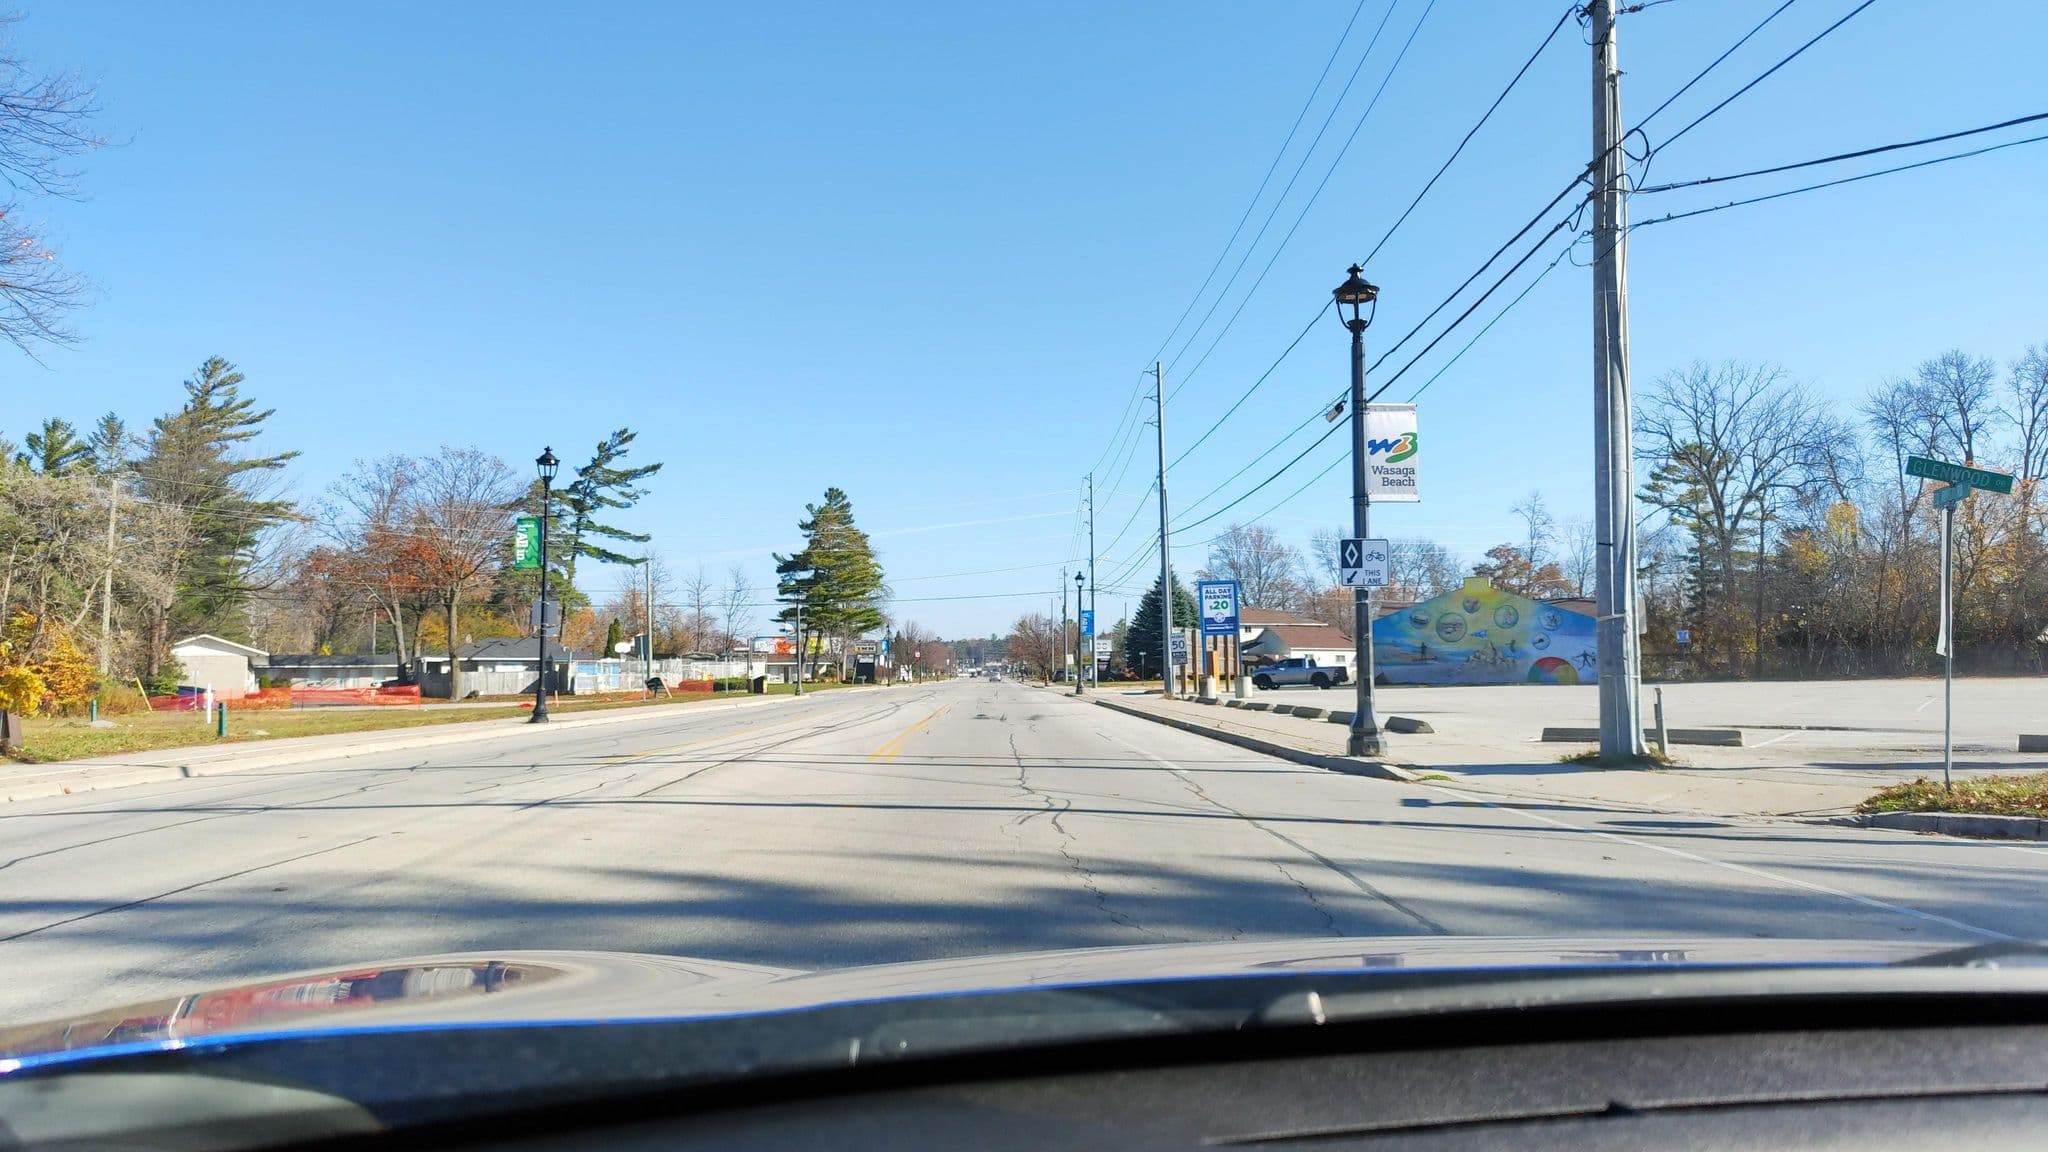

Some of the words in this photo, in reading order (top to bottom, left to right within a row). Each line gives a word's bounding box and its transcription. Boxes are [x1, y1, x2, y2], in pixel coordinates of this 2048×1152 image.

[1371, 465, 1415, 477] Wasaga
[1913, 460, 1990, 487] GLENWOOD
[1382, 477, 1415, 487] Beach
[1364, 569, 1381, 577] THIS
[1362, 577, 1382, 585] LANE
[1172, 640, 1185, 650] 50
